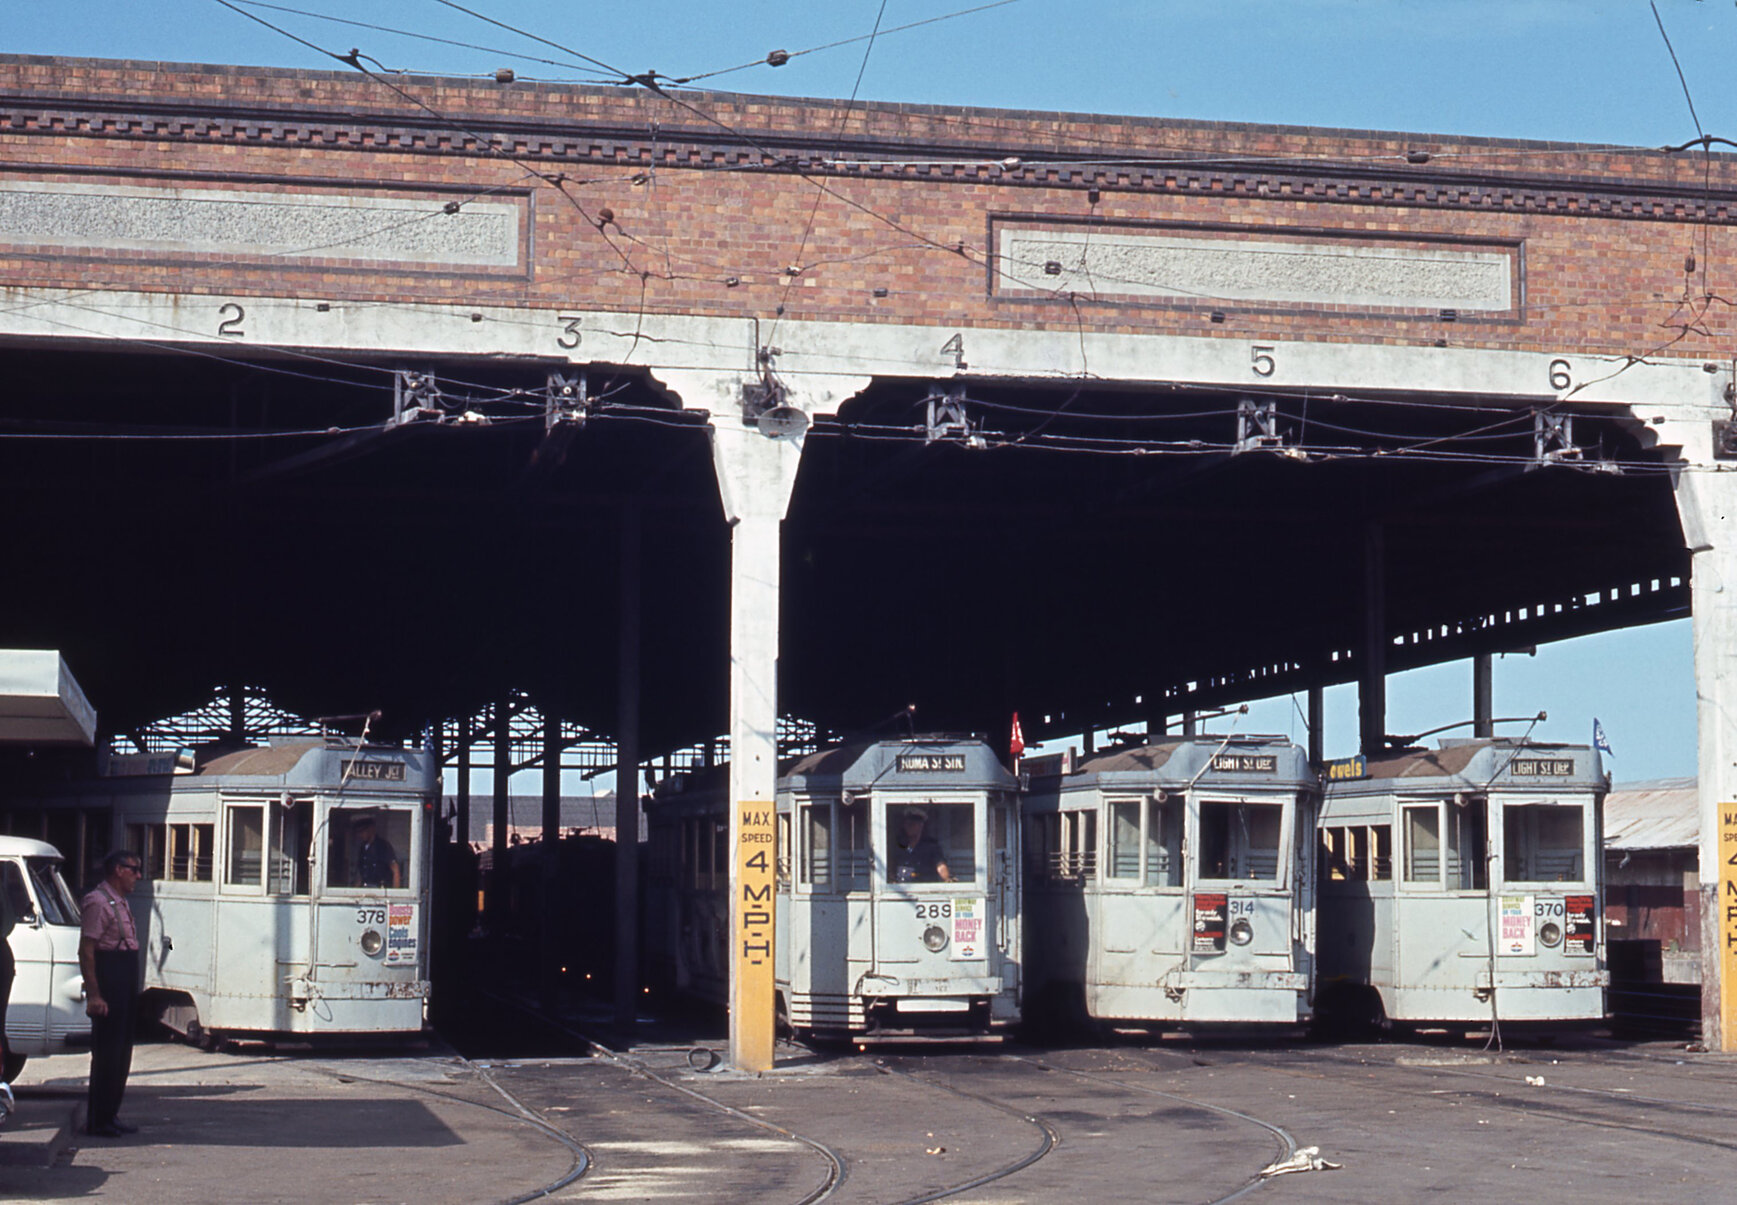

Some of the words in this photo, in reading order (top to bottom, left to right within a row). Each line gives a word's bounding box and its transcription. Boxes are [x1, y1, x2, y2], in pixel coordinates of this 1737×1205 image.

[218, 303, 245, 336] 2
[557, 316, 582, 350] 3
[940, 333, 965, 364] 4
[1251, 346, 1275, 378] 5
[1549, 359, 1571, 390] 6
[1214, 757, 1239, 770] LIGHT
[1513, 760, 1537, 775] LIGHT
[741, 833, 773, 844] SPEED
[745, 850, 770, 874] 4
[915, 904, 951, 919] 289
[1229, 901, 1255, 915] 314
[1534, 903, 1563, 917] 370
[356, 910, 385, 924] 378
[389, 915, 412, 926] power
[955, 918, 982, 930] MONEY
[1503, 916, 1531, 927] MONEY
[955, 930, 976, 942] BACK
[1503, 928, 1525, 939] BACK
